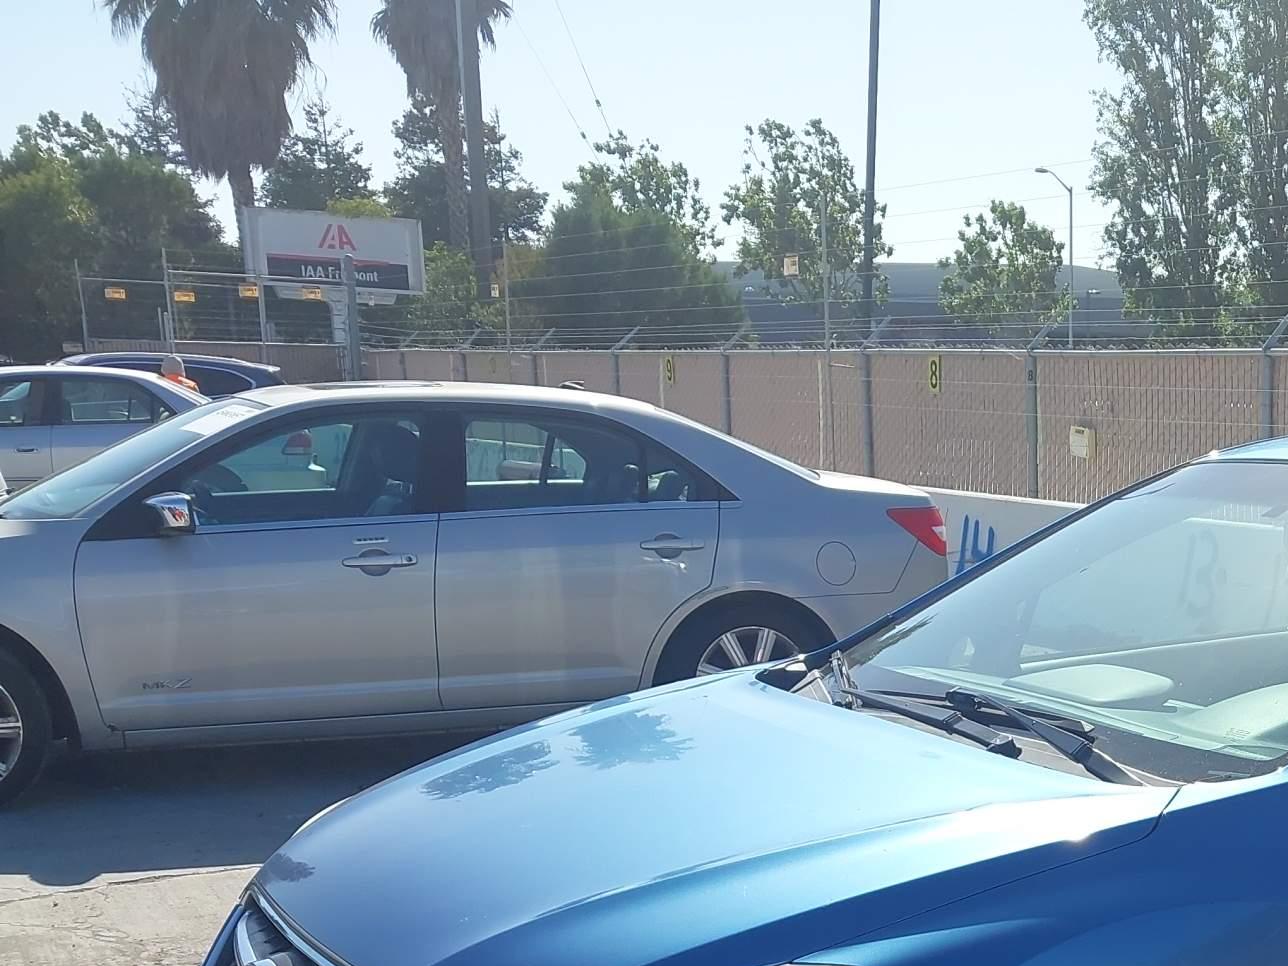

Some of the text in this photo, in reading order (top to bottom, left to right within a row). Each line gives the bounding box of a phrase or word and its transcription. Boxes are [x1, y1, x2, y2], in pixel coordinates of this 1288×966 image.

[301, 264, 379, 282] IAA Front
[666, 359, 673, 382] 9
[930, 360, 938, 389] 8
[955, 514, 995, 575] 14
[141, 678, 192, 689] MKZ
